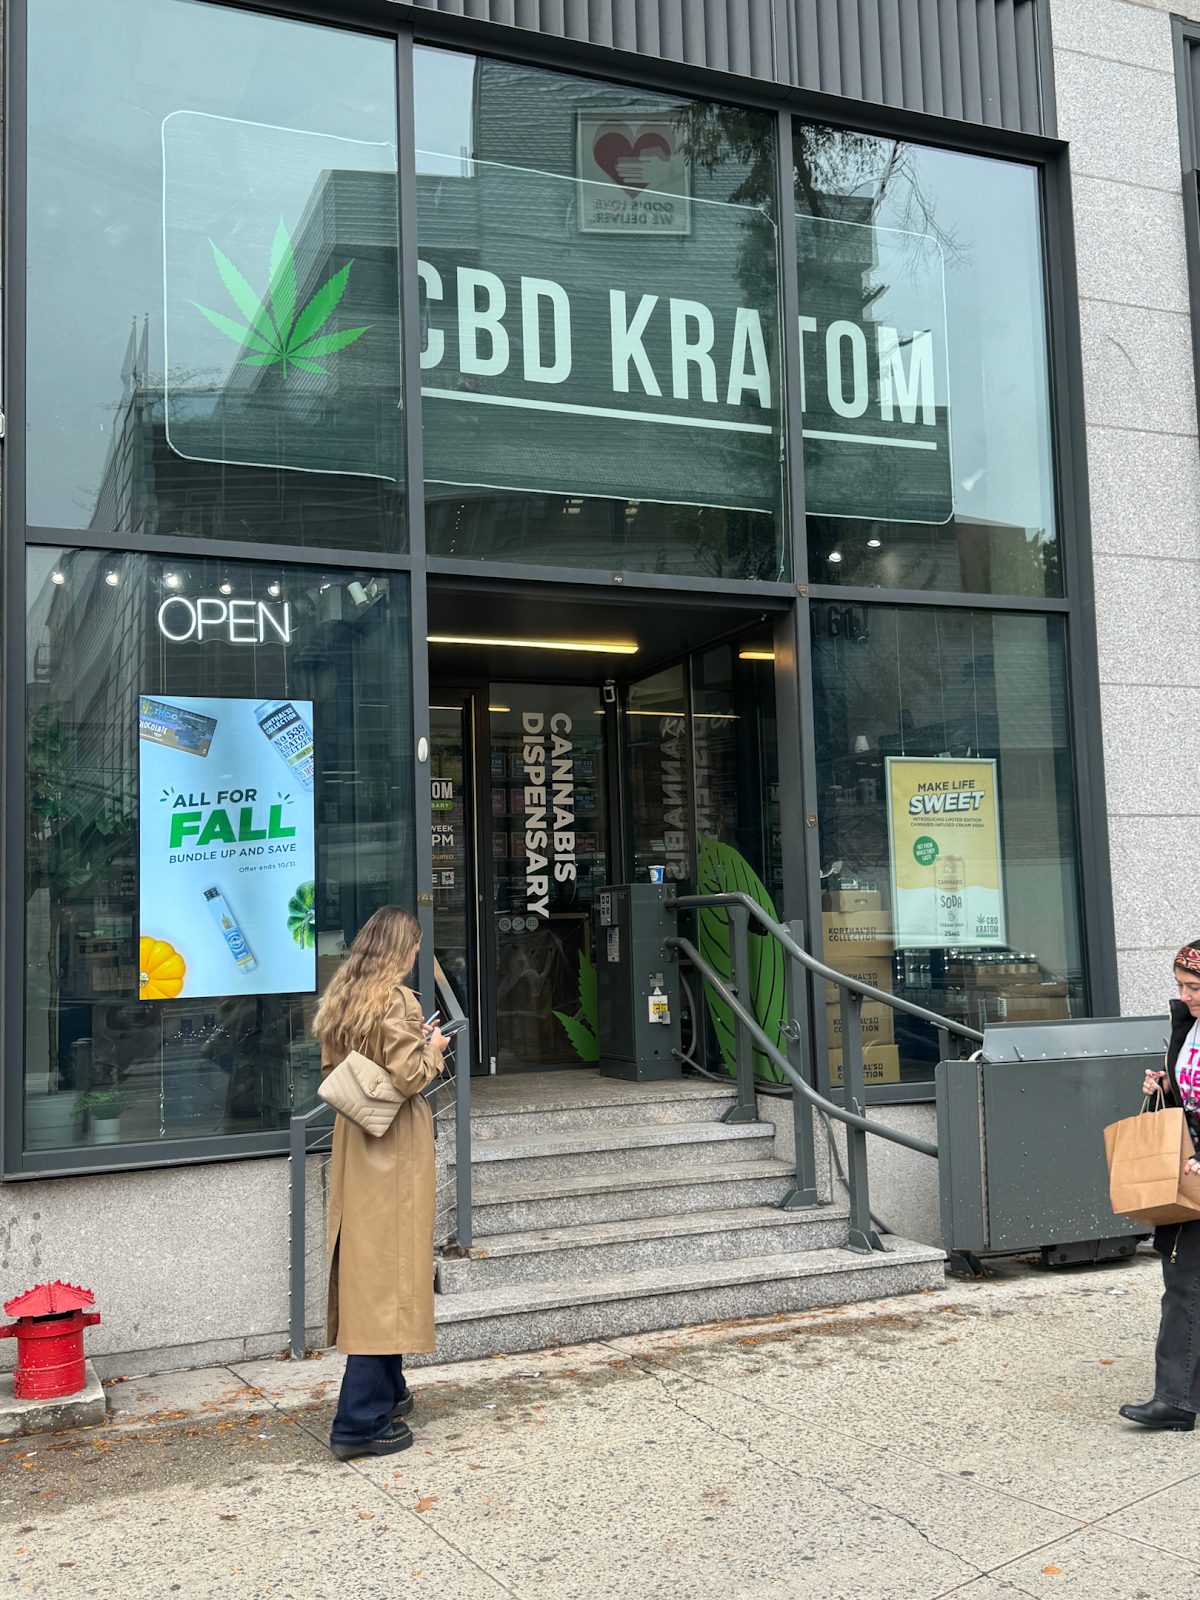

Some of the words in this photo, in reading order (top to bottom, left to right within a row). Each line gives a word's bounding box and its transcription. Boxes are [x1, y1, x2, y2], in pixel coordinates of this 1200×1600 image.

[417, 259, 572, 384] CBD
[609, 289, 937, 426] KRATOM
[158, 596, 290, 643] OPEN
[140, 720, 168, 735] HOCOLATE
[266, 713, 297, 735] COLLECTION
[287, 724, 305, 740] 539
[279, 731, 310, 754] KRATOM
[282, 737, 312, 760] SELTZER
[917, 781, 949, 792] MAKE
[952, 779, 976, 790] LIFE
[172, 792, 211, 808] ALL
[217, 788, 258, 804] FOR
[549, 712, 577, 883] CANNABIS
[908, 790, 985, 815] SWEET
[522, 712, 550, 919] DISPENSARY
[169, 804, 296, 849] FALL
[169, 851, 218, 864] BUNDLE
[221, 849, 236, 859] UP
[239, 846, 265, 857] AND
[267, 843, 297, 854] SAVE
[278, 861, 296, 869] 10/31
[940, 894, 963, 909] SODA
[975, 925, 999, 934] KRATOM
[986, 916, 999, 925] CBD
[828, 934, 877, 942] COLLECTION
